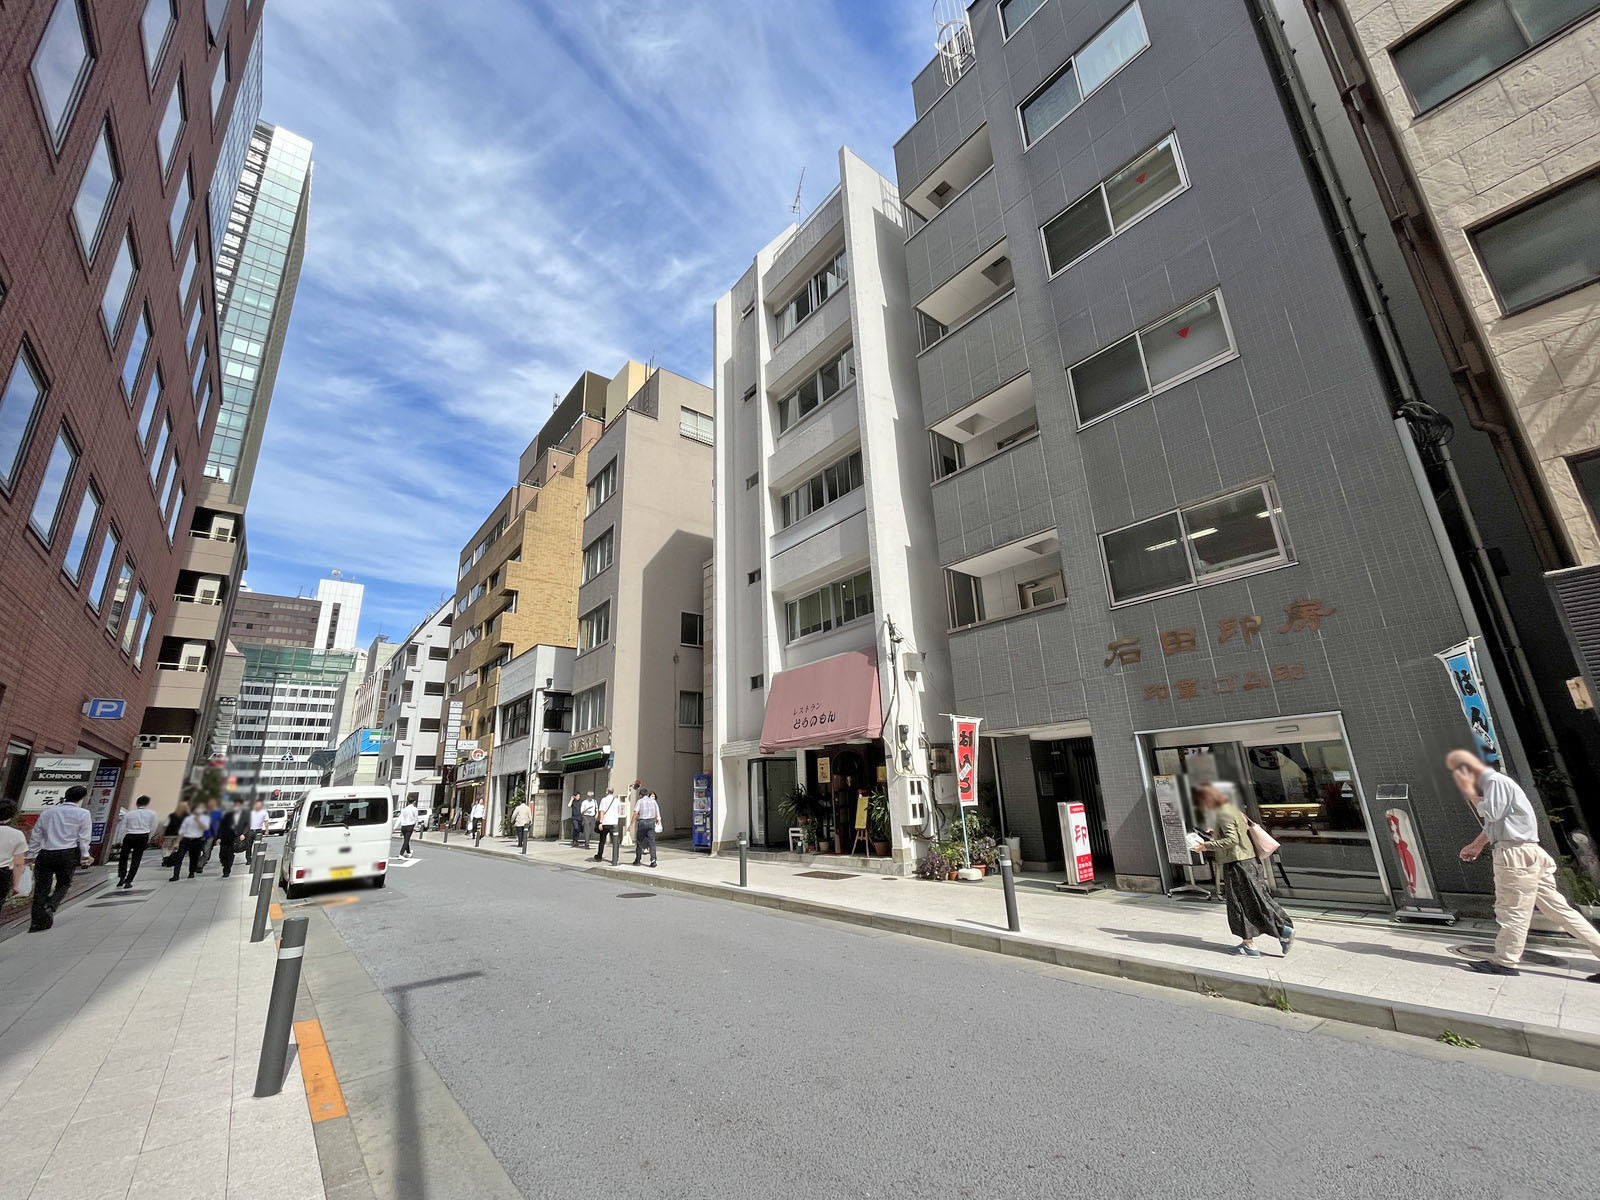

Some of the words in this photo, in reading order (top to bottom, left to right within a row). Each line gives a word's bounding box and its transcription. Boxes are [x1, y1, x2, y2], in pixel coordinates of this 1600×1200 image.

[95, 701, 118, 716] P
[793, 702, 822, 716] レストラン
[793, 710, 836, 730] とらのもん
[38, 772, 82, 780] KOHINOOR
[1074, 824, 1088, 846] 印
